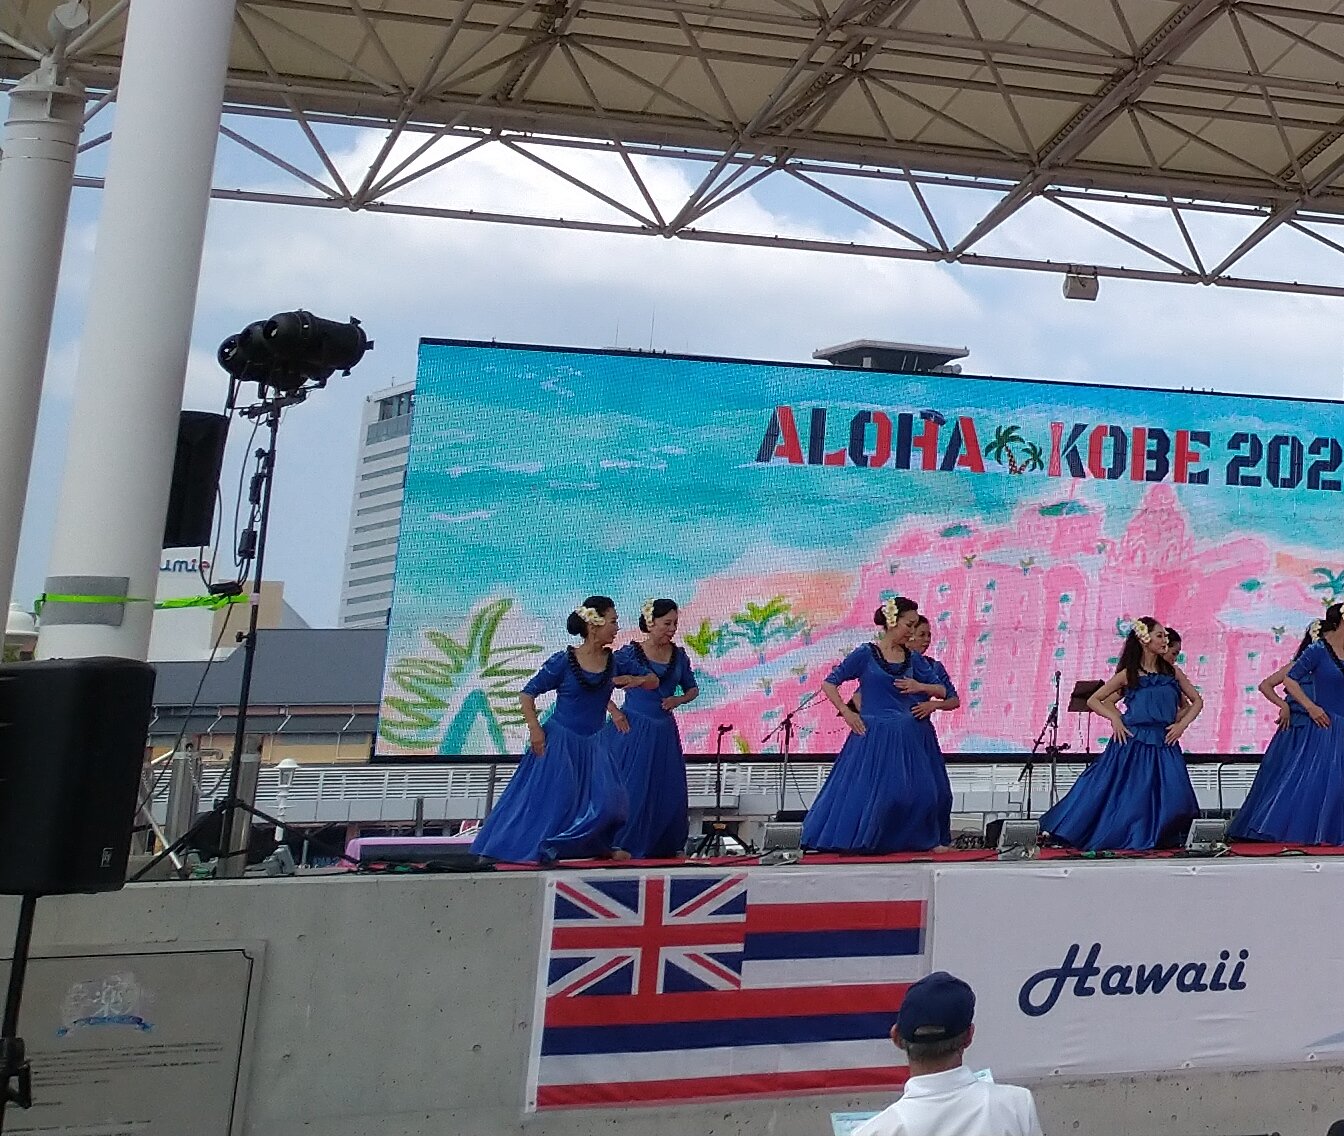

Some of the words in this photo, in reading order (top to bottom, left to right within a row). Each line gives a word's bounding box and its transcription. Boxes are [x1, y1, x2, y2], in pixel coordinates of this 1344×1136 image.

[756, 405, 986, 473] ALOHA
[1048, 420, 1213, 483] KOBE
[1018, 942, 1249, 1017] Hawaii
